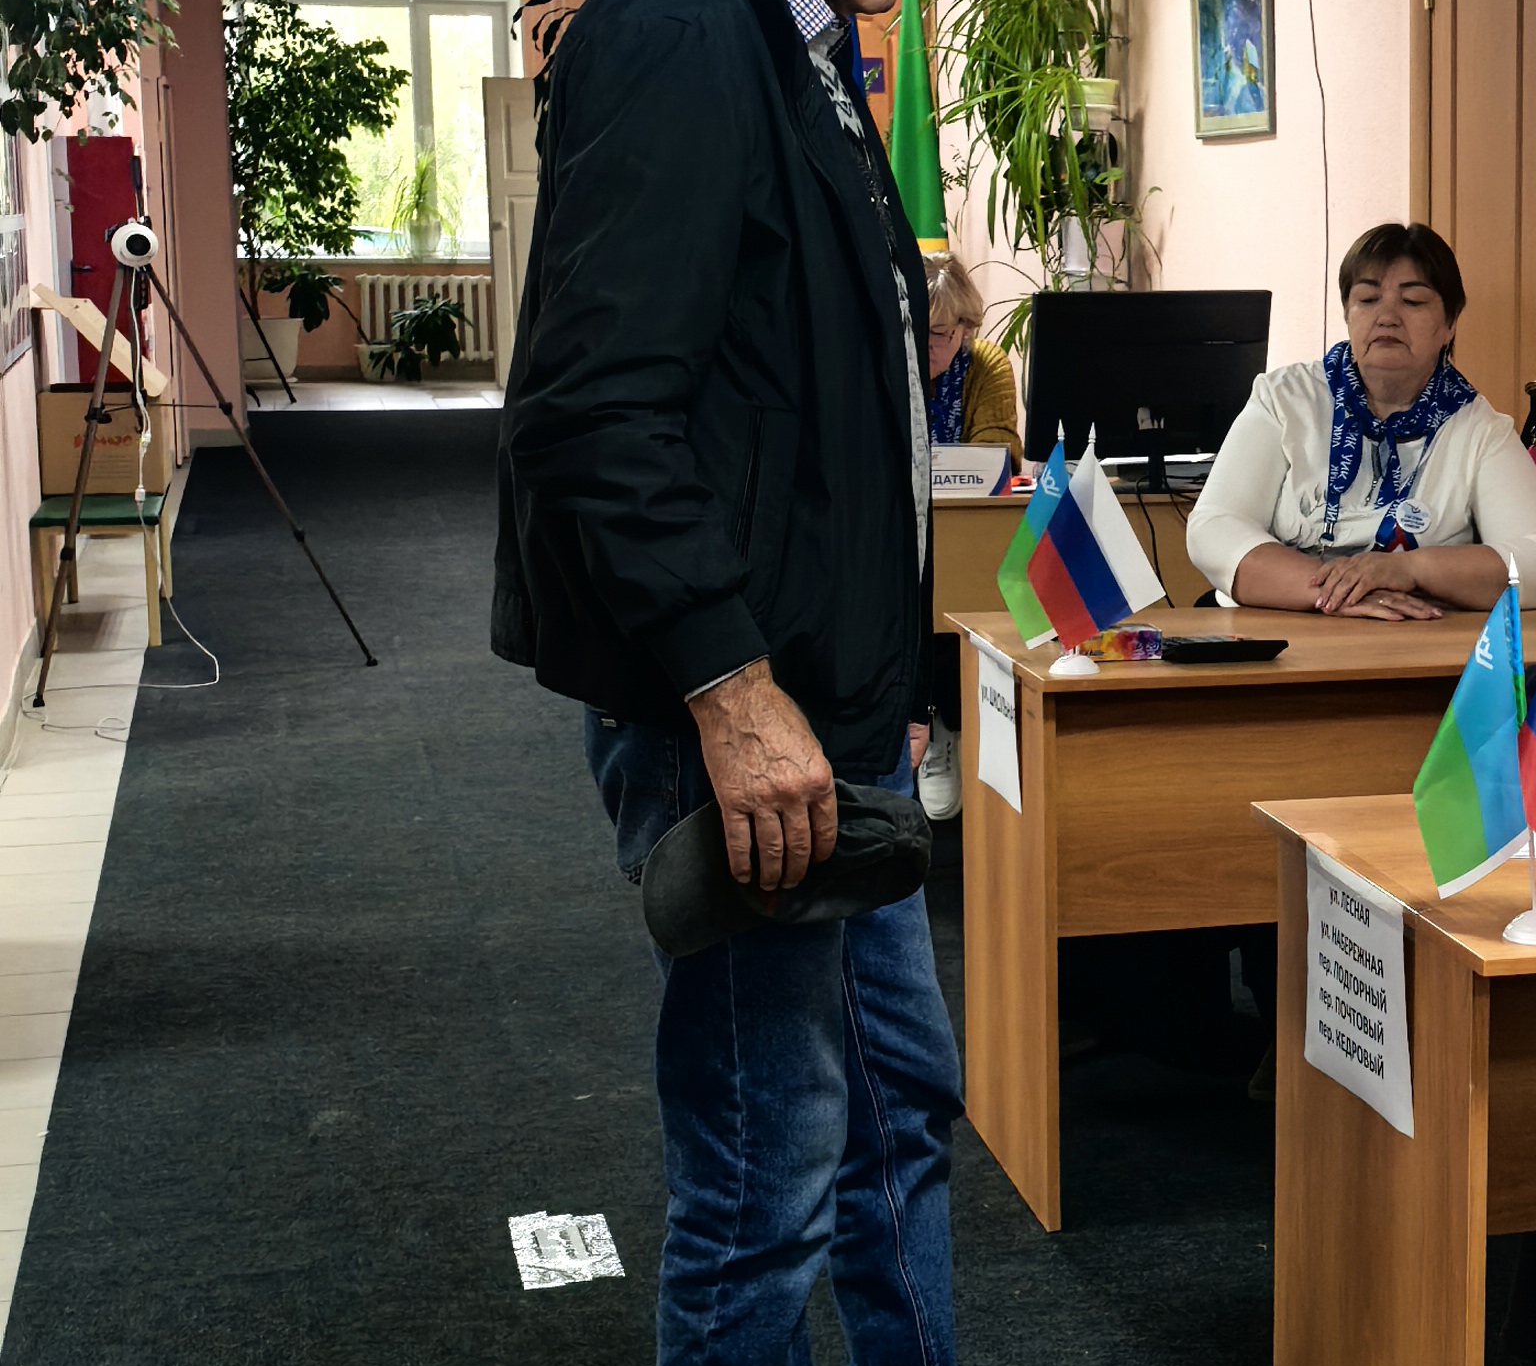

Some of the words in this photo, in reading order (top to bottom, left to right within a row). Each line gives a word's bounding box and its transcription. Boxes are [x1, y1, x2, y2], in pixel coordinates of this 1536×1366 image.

[1339, 454, 1353, 480] УИК
[1329, 886, 1340, 906] ул.
[1341, 891, 1370, 928] ЛЕСНАЯ
[1321, 920, 1331, 939] ул.
[1331, 925, 1384, 979] НАБЕРЕЖНАЯ
[1319, 952, 1332, 976] пер.
[1333, 960, 1387, 1014] ПОДГОРНЫЙ
[1319, 987, 1333, 1011] пер.
[1335, 996, 1384, 1046] ПОЧТОВЫЙ
[1319, 1019, 1334, 1045] пер.
[1335, 1029, 1384, 1080] КЕДРОВЫЙ
